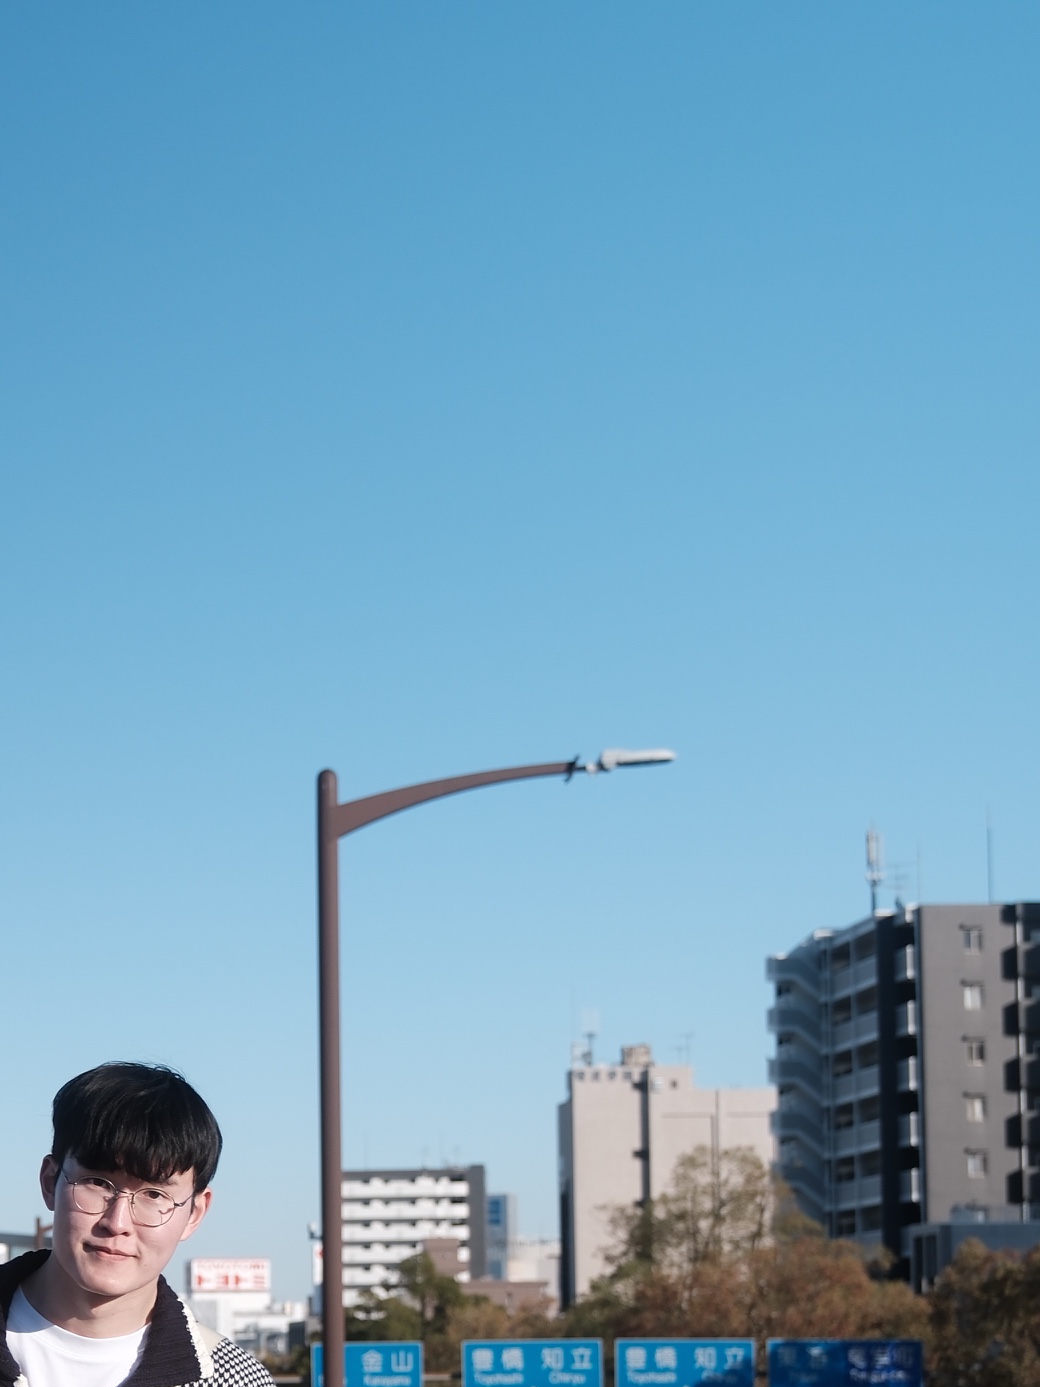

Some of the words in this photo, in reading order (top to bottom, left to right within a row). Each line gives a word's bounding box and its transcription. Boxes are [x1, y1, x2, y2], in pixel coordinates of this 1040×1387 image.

[196, 1274, 265, 1289] トヨトミ
[361, 1349, 414, 1373] 金山
[541, 1346, 593, 1370] 知立
[694, 1346, 745, 1370] 知立
[363, 1374, 411, 1387] Kanayama
[473, 1372, 524, 1386] Toyohashi
[548, 1370, 587, 1385] Chiryu
